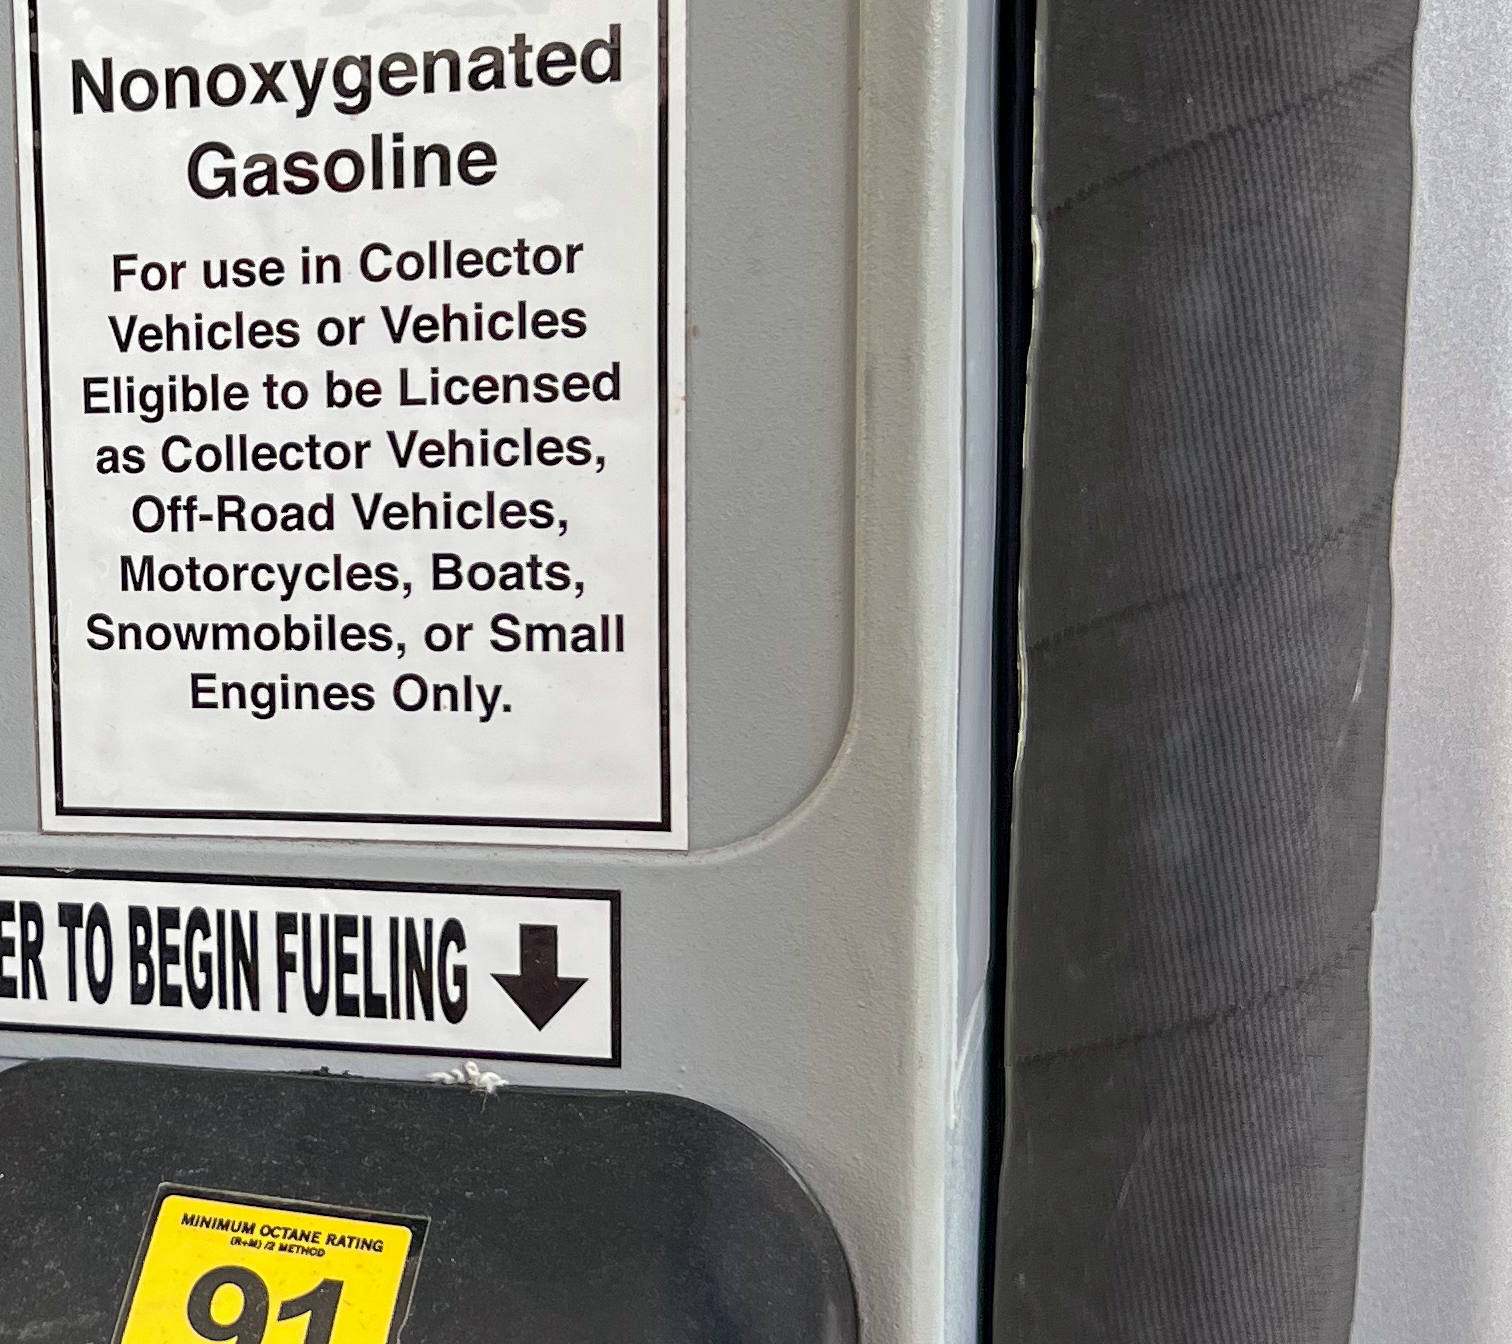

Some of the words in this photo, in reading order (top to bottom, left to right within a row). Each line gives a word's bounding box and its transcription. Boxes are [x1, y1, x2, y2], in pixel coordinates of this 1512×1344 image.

[72, 24, 621, 118] Nonoxygenated
[188, 132, 497, 199] Gasoline
[113, 254, 186, 291] For
[204, 257, 284, 288] use
[302, 246, 340, 284] in
[360, 239, 583, 282] Collector
[108, 311, 299, 352] Vehicles
[318, 316, 365, 346] or
[381, 301, 586, 343] Vehicles
[83, 374, 249, 423] Eligible
[263, 374, 308, 409] to
[327, 370, 381, 408] be
[400, 362, 620, 406] Licensed
[97, 446, 145, 474] as
[162, 434, 371, 472] Collector
[386, 428, 604, 473] Vehicles,
[133, 494, 334, 532] Off-Road
[352, 491, 567, 536] Vehicles,
[121, 554, 411, 601] Motorcycles,
[432, 553, 583, 598] Boats,
[87, 613, 405, 659] Snowmobiles,
[425, 623, 473, 651] or
[490, 613, 623, 652] Small
[191, 673, 374, 719] Engines
[394, 674, 511, 722] Only.
[58, 902, 113, 1004] TO
[129, 906, 259, 1011] BEGIN
[276, 912, 467, 1024] FUELING
[180, 1212, 256, 1235] MINIMUM
[259, 1224, 322, 1244] OCTANE
[325, 1233, 384, 1253] RATING
[277, 1243, 326, 1258] METHOD
